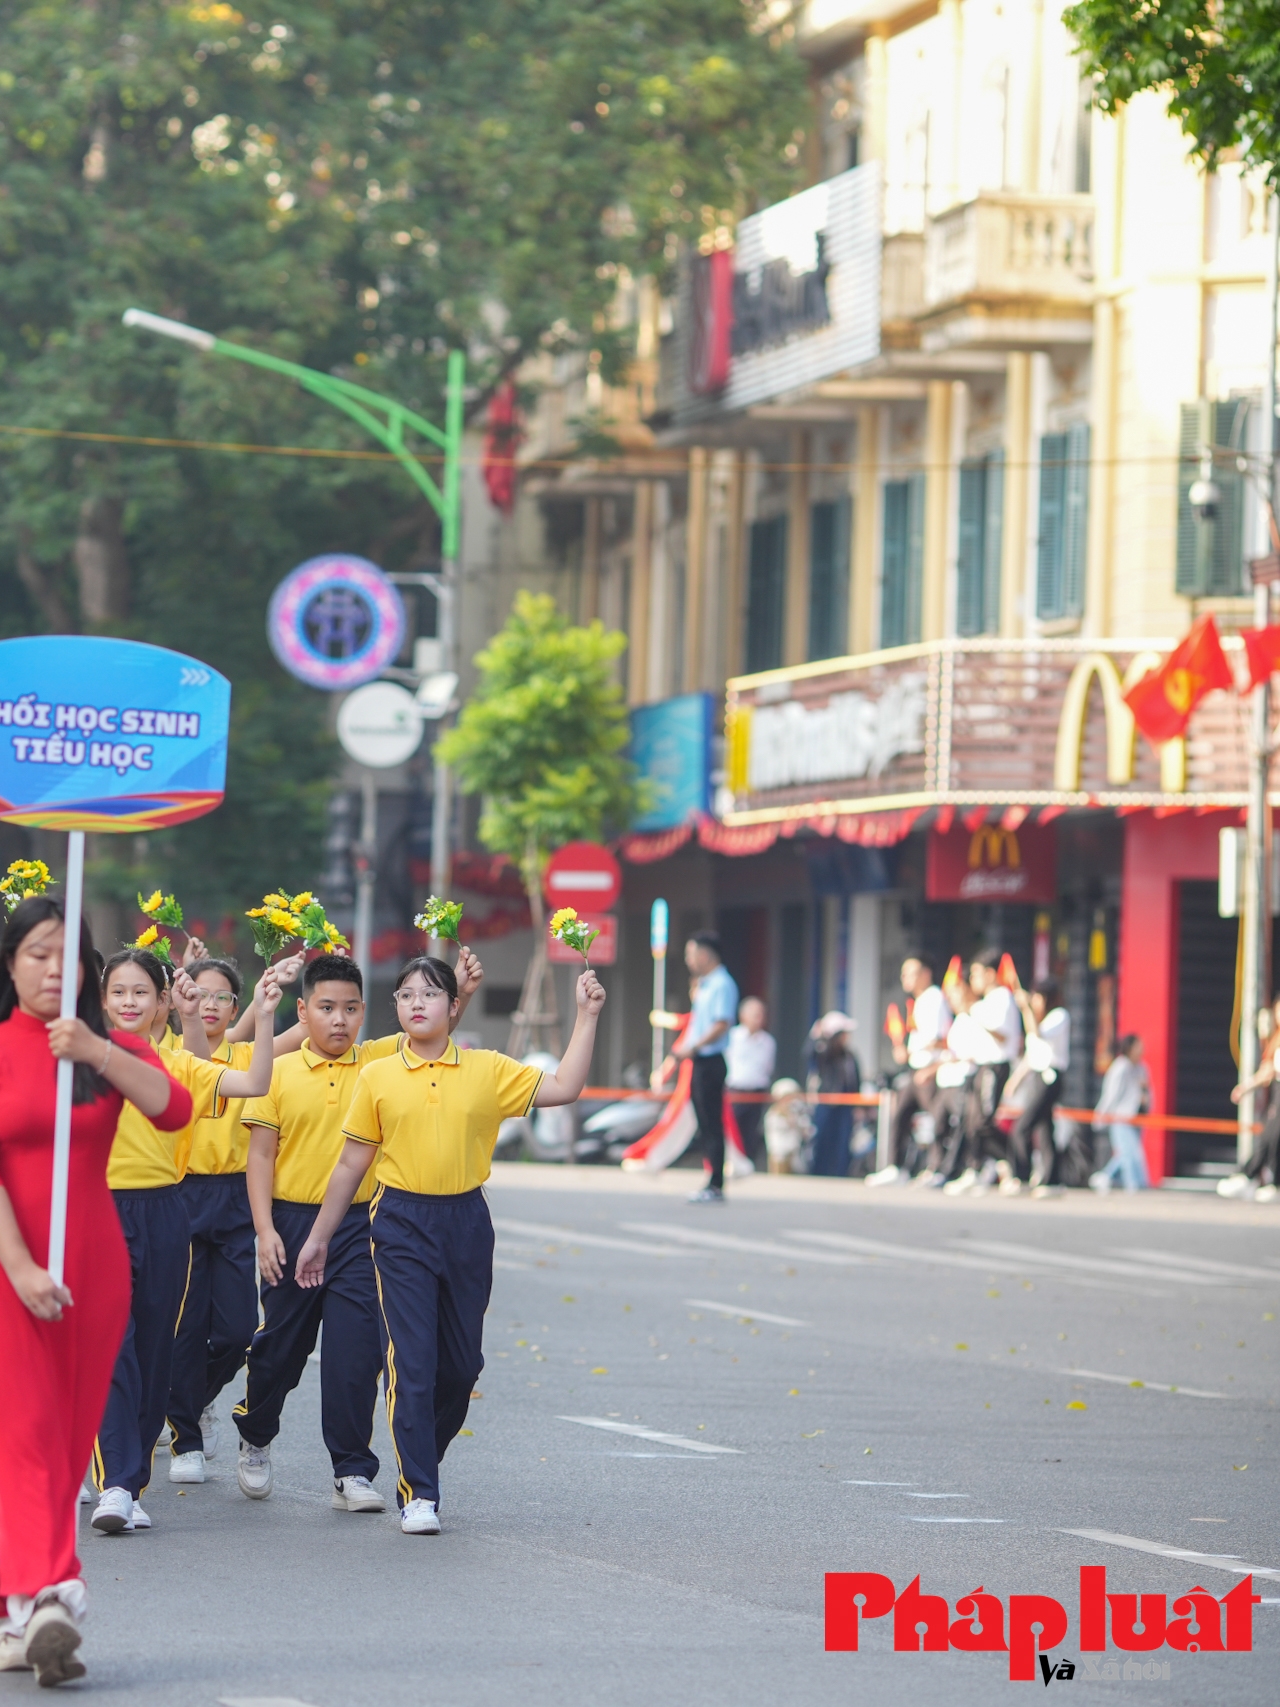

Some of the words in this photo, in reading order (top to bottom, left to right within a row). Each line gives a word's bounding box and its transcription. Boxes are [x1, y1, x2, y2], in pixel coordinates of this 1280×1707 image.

[55, 704, 118, 737] HỌC
[121, 709, 199, 737] SINH
[12, 729, 86, 765] TIỂU
[89, 741, 153, 776] HỌC
